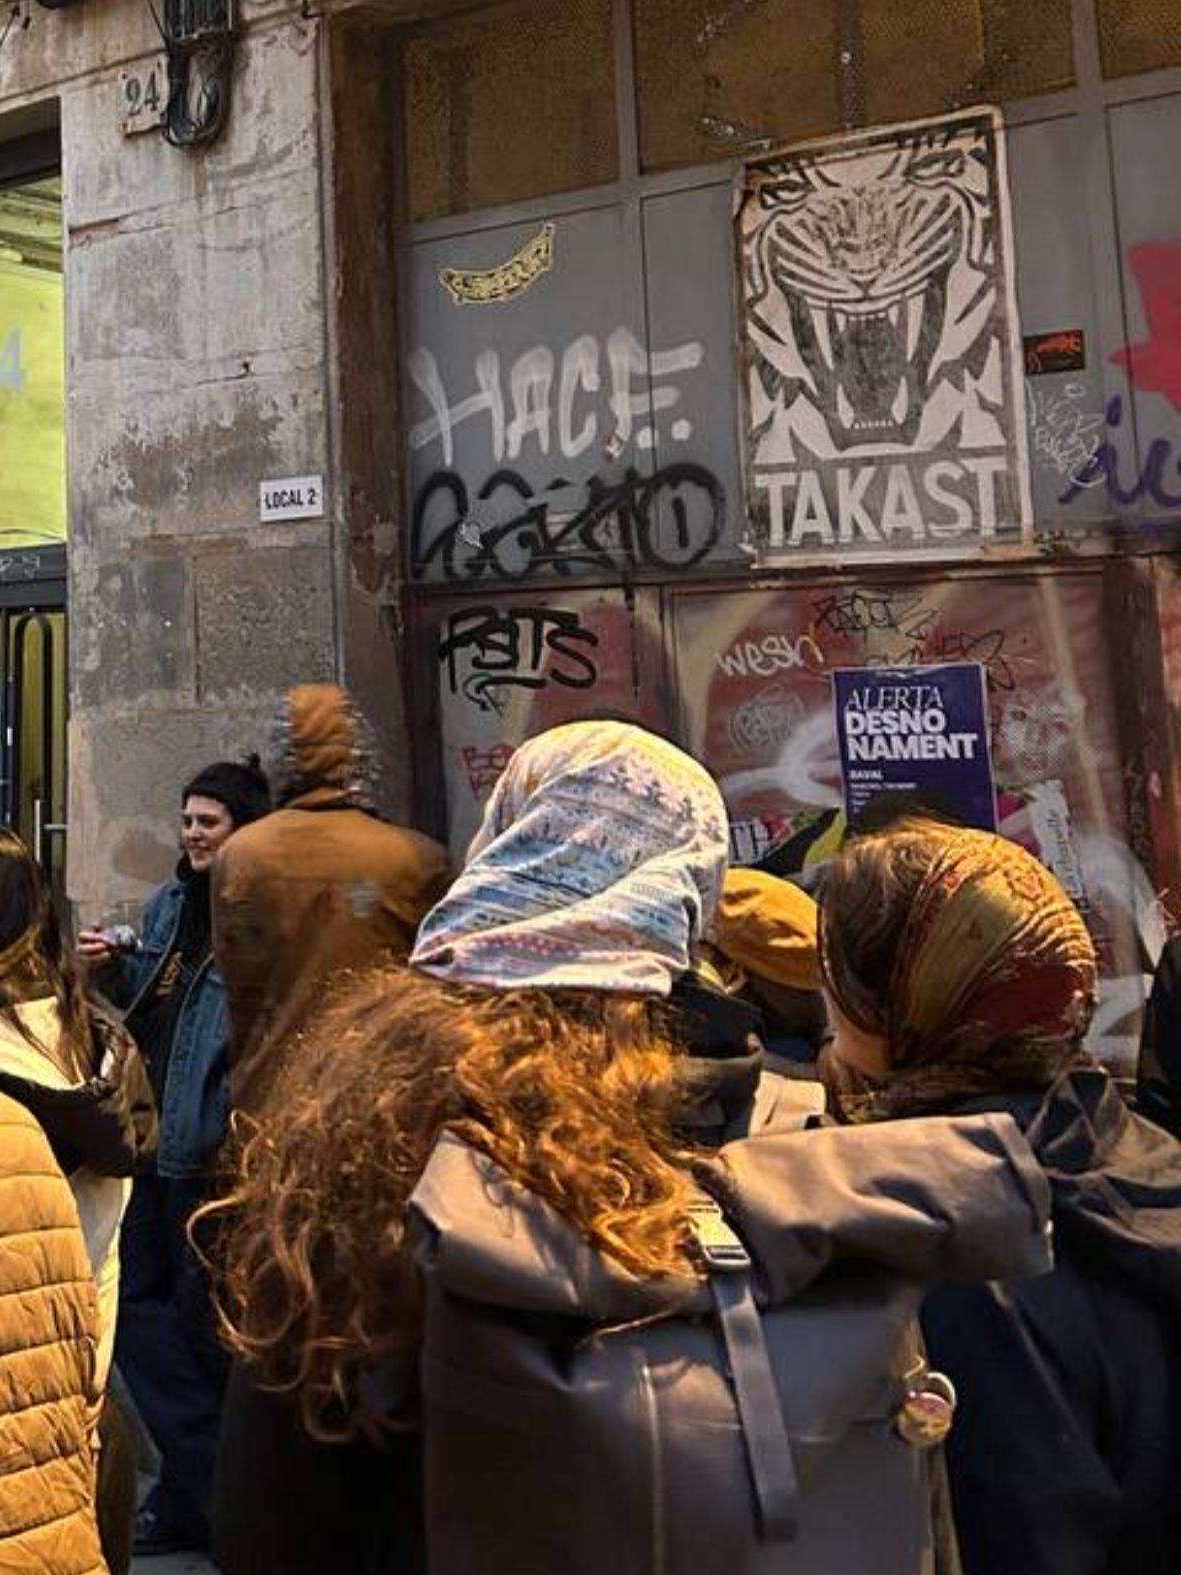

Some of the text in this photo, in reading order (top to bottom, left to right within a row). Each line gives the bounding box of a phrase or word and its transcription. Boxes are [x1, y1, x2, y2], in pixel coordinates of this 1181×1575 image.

[264, 486, 317, 510] LOCAL 2
[754, 456, 1008, 547] TAKAST
[846, 686, 944, 711] ALERTA
[845, 708, 946, 735] DESNO
[848, 732, 978, 762] NAMENT
